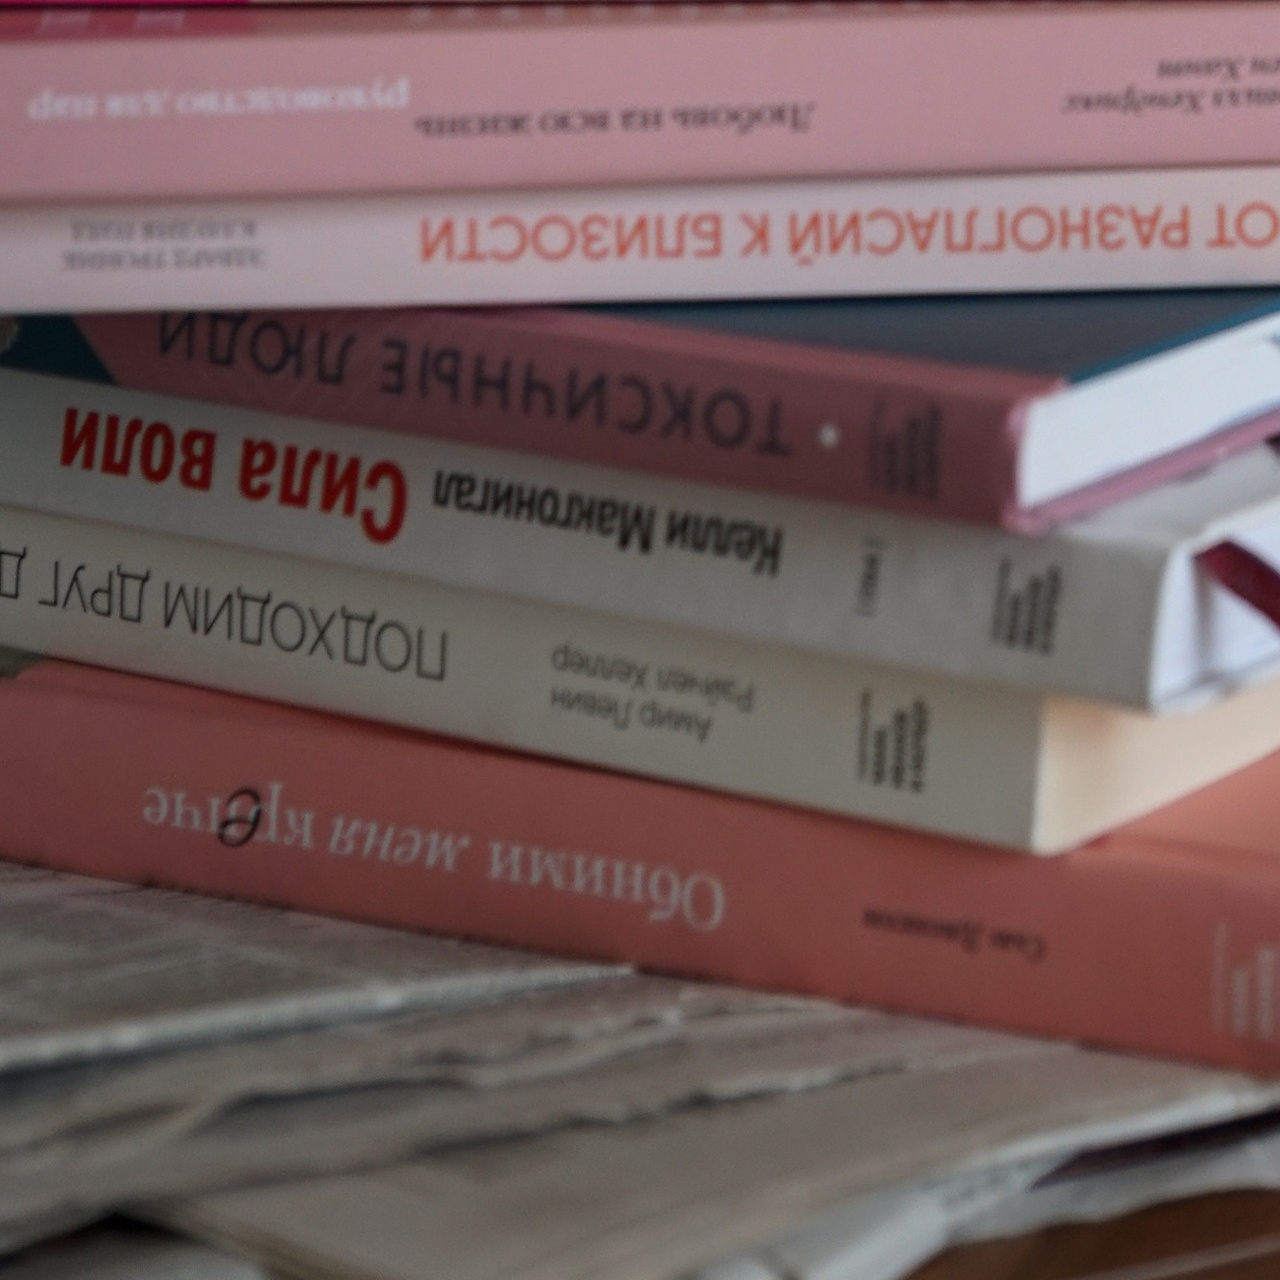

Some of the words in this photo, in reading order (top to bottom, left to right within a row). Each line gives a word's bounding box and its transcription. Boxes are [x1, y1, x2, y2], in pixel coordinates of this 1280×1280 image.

[414, 112, 532, 138] жизнь
[538, 109, 610, 134] всю
[619, 108, 664, 132] на
[671, 102, 815, 135] Любовь
[418, 211, 723, 263] БЛИЗОСТИ
[741, 215, 769, 258] К
[788, 203, 1190, 266] РАЗНОГЛАСИЙ
[1207, 202, 1280, 249] ОТ
[158, 310, 355, 385] ЛЮДИ
[380, 338, 790, 457] ТОКСИЧНЫЕ
[60, 408, 216, 492] воли
[238, 438, 407, 545] Сила
[433, 471, 656, 555] Макгонигал
[665, 511, 784, 577] Келли
[38, 561, 150, 623] ДРУГ
[163, 581, 447, 682] ПОДХОДИМ
[551, 644, 649, 693] Хеллер
[551, 688, 633, 730] Левин
[639, 701, 712, 744] Амир
[142, 783, 314, 849] крепче
[329, 815, 470, 871] меня
[488, 842, 725, 931] Обними
